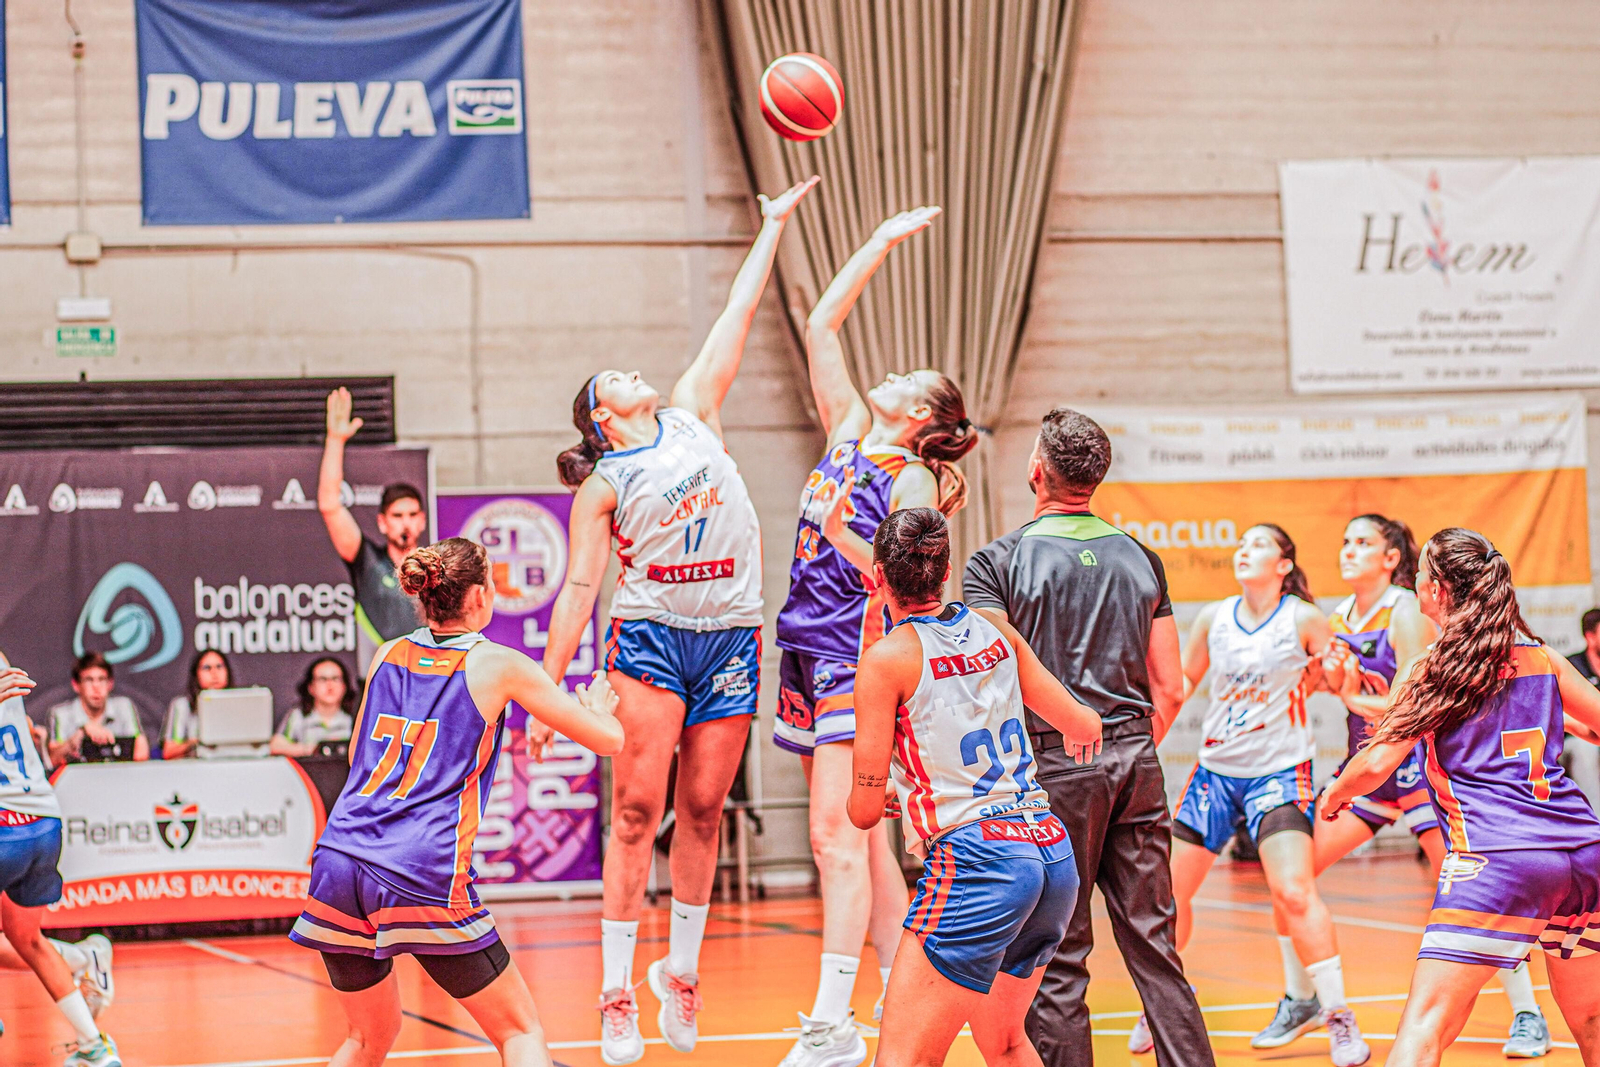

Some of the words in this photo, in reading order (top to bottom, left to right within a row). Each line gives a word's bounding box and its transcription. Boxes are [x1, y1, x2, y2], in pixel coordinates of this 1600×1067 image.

[143, 73, 437, 140] PULEVA
[1354, 212, 1535, 275] Heem
[662, 466, 711, 505] TENERIFE
[684, 516, 708, 555] 17
[195, 576, 355, 619] balonces
[195, 617, 355, 653] andaluci
[0, 724, 30, 786] 9
[356, 713, 440, 802] 77
[959, 717, 1043, 798] 22
[1500, 727, 1551, 803] 7
[66, 813, 152, 846] Reina
[200, 805, 287, 839] Isabel
[47, 880, 134, 912] ANADA
[135, 875, 187, 899] MÁS
[190, 874, 309, 901] BALONCES
